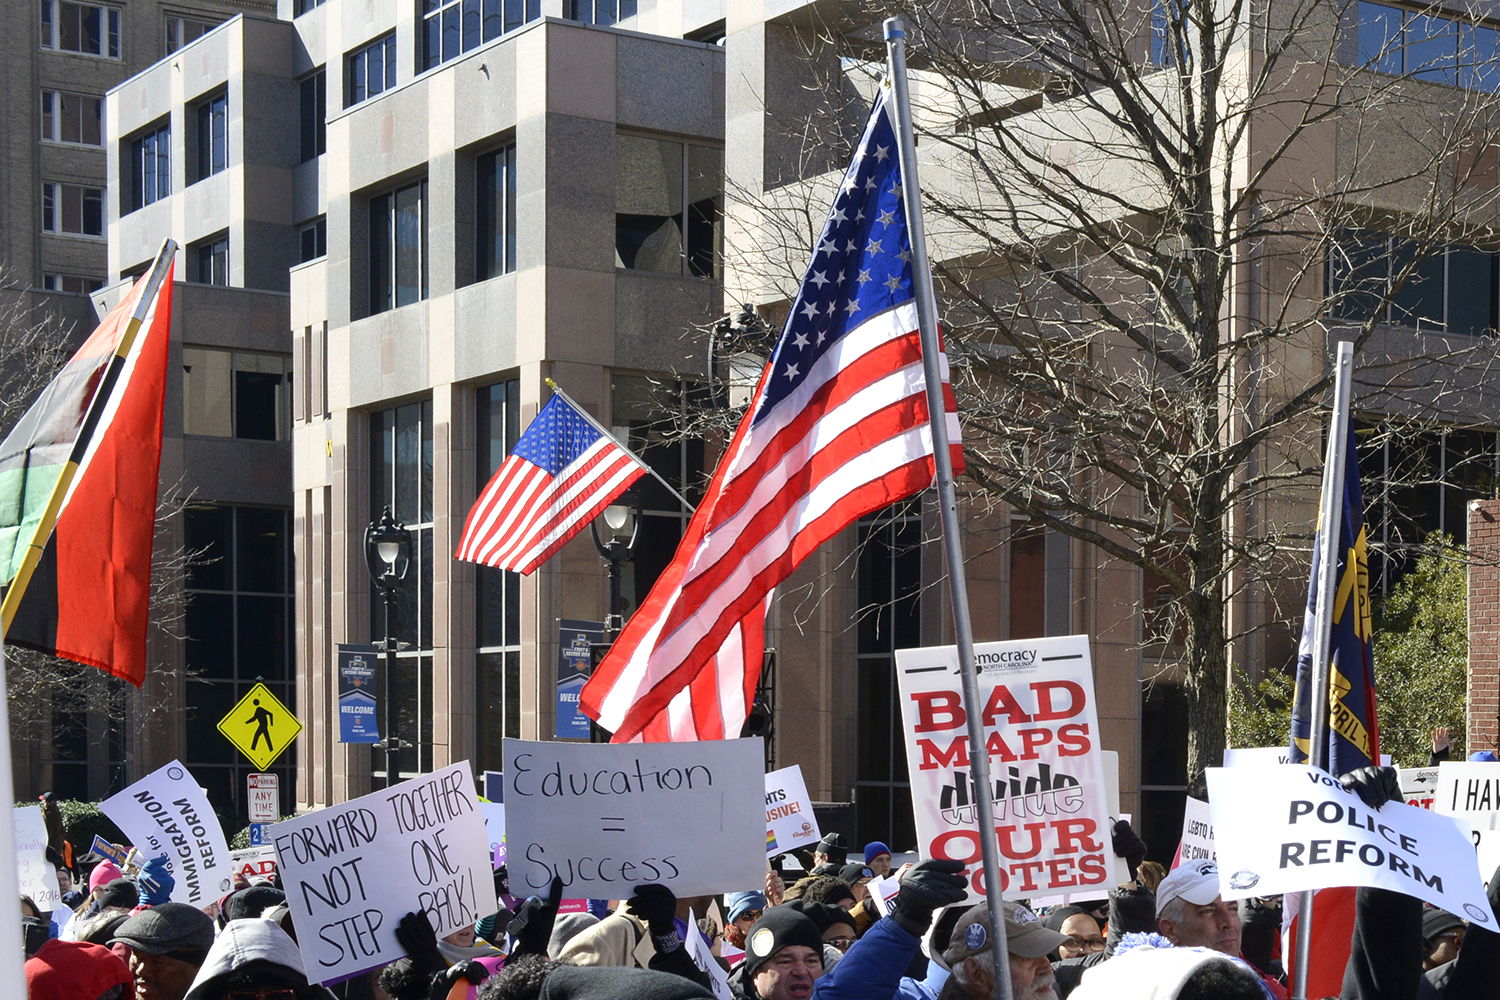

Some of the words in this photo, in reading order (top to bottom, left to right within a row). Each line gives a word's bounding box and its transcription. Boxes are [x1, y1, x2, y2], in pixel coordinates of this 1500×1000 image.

[974, 650, 1037, 664] mocracy
[1003, 661, 1032, 669] CAROLINA
[341, 705, 374, 714] WELCOME
[910, 679, 1087, 733] BAD
[916, 722, 1092, 771] MAPS
[255, 791, 272, 801] ANY
[513, 752, 713, 797] Education
[254, 802, 273, 812] TIME
[275, 808, 378, 870] FORWARD
[387, 770, 474, 834] TOGETHER
[766, 801, 802, 823] USIVE!
[1188, 819, 1208, 839] LGBTQ
[1288, 799, 1420, 857] POLICE
[133, 790, 201, 903] IMMIGRATION
[145, 835, 162, 852] for
[172, 797, 216, 871] REFORM
[929, 817, 1104, 860] OUR
[241, 860, 276, 877] AD
[300, 857, 363, 916] NOT
[410, 827, 463, 886] ONE
[525, 841, 681, 890] Success
[964, 854, 1107, 895] OTES
[1279, 839, 1445, 895] REFORM
[318, 908, 384, 967] STEP
[418, 881, 477, 940] BACK!
